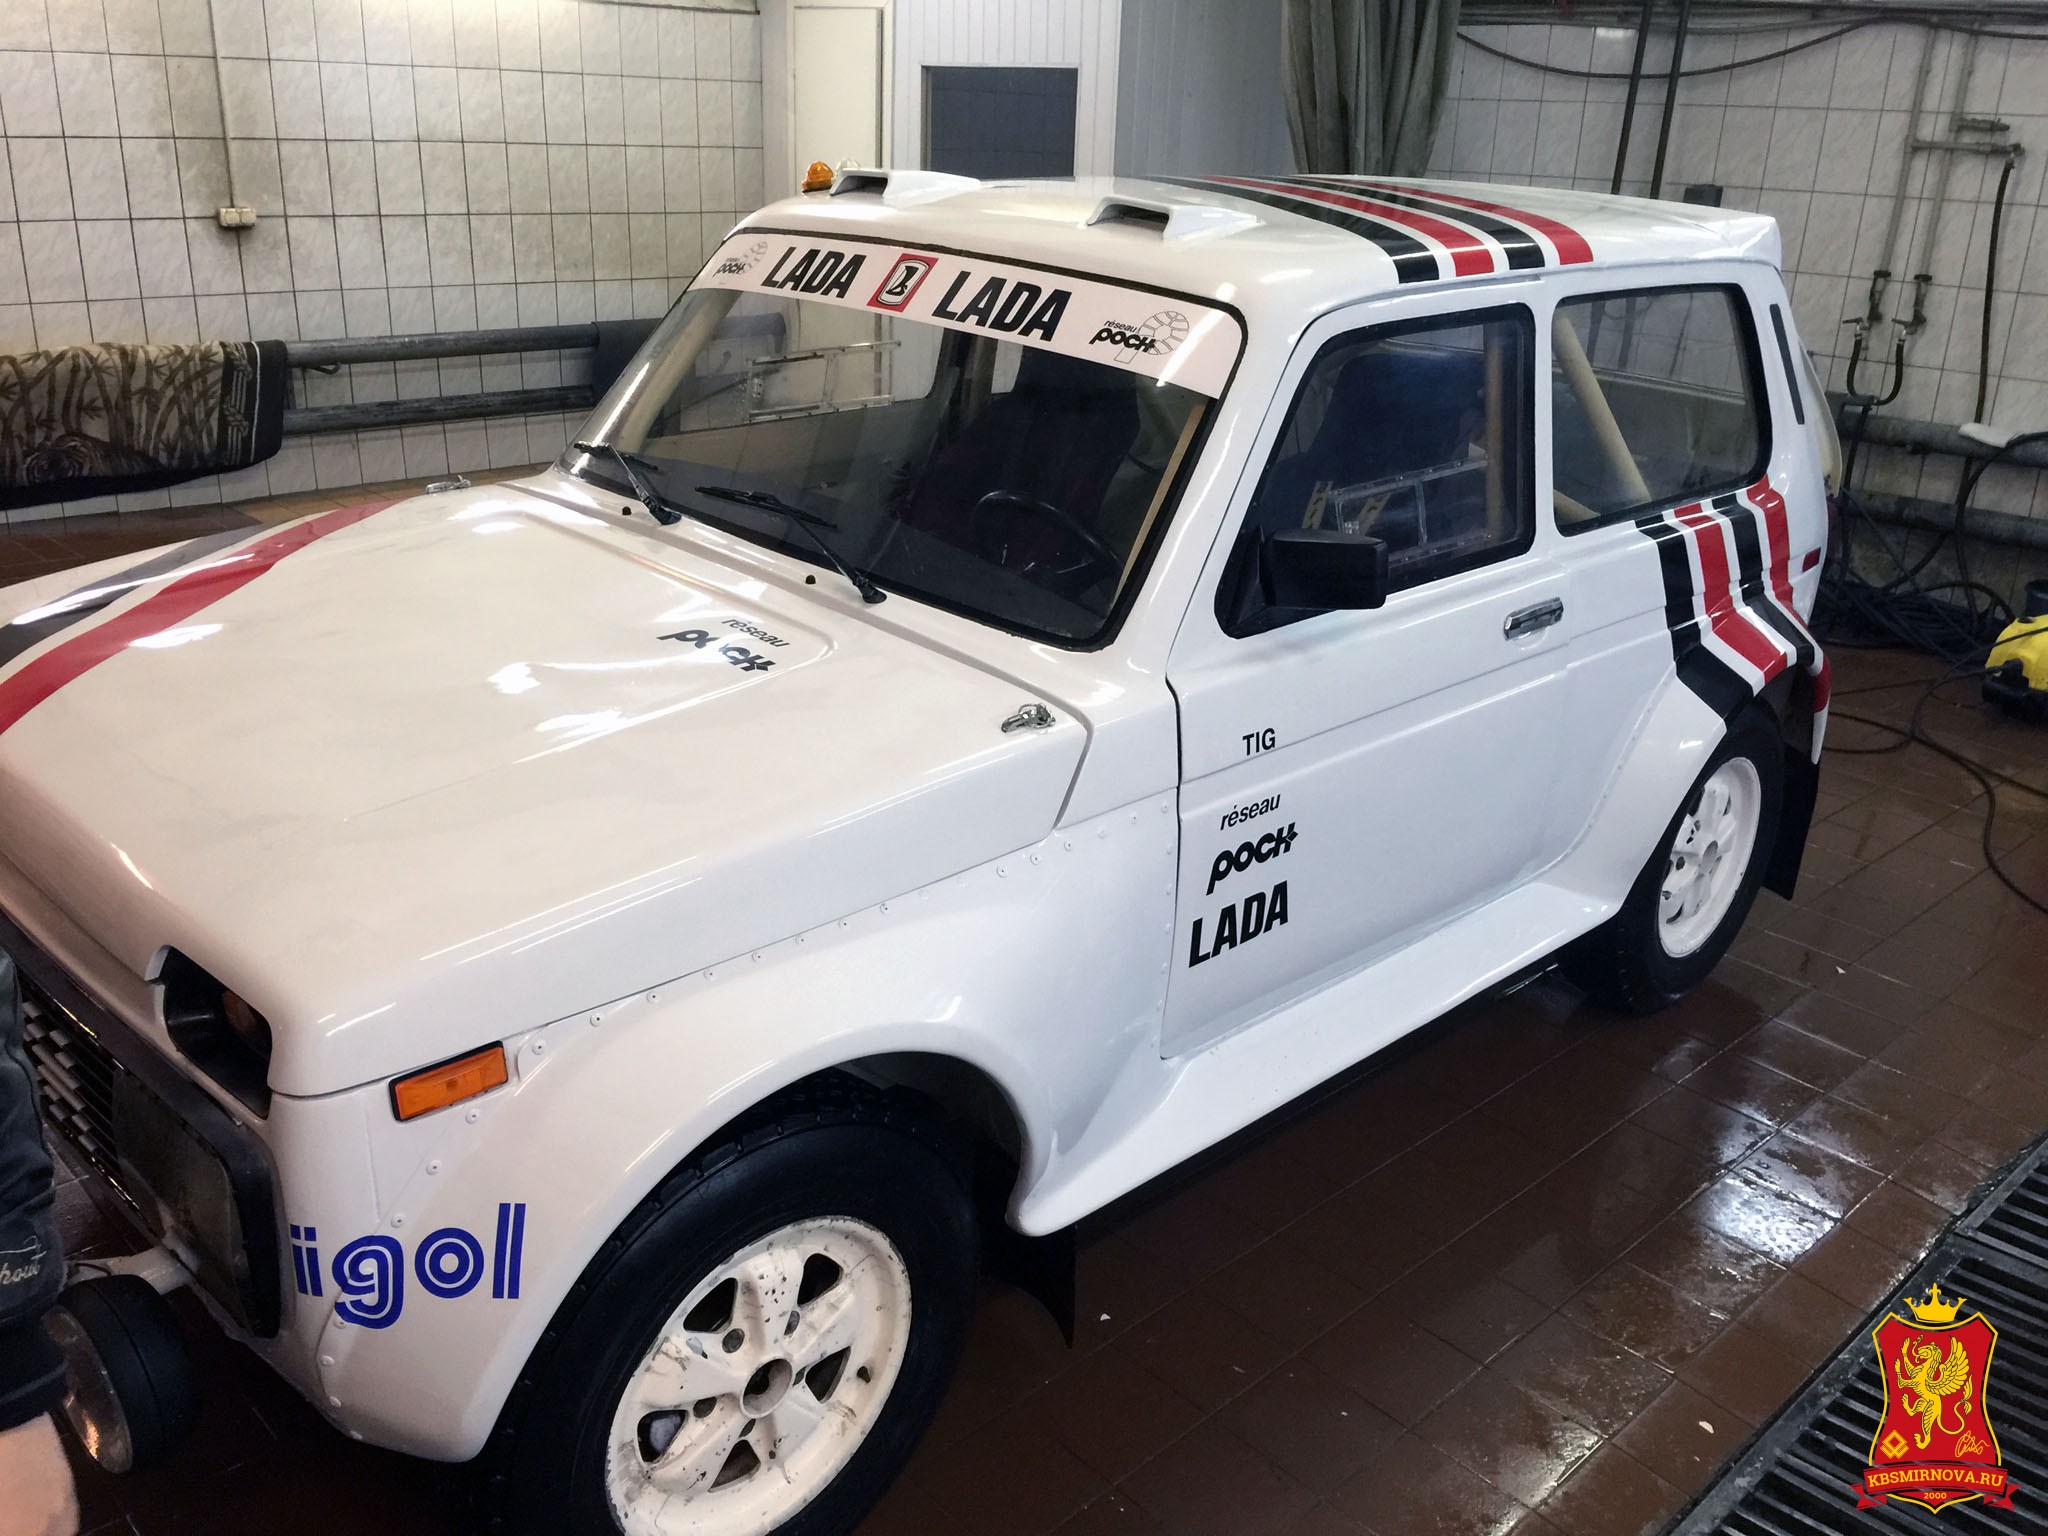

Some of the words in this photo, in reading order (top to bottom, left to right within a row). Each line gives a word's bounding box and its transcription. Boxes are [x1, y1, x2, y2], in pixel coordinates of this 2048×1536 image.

[760, 246, 867, 299] LADA
[931, 270, 1072, 342] LADA
[1103, 319, 1138, 333] réseau
[721, 618, 790, 648] réseau
[1242, 728, 1276, 756] TIG
[1220, 794, 1281, 831] réseau
[1188, 880, 1288, 968] LADA
[290, 1202, 527, 1330] igol
